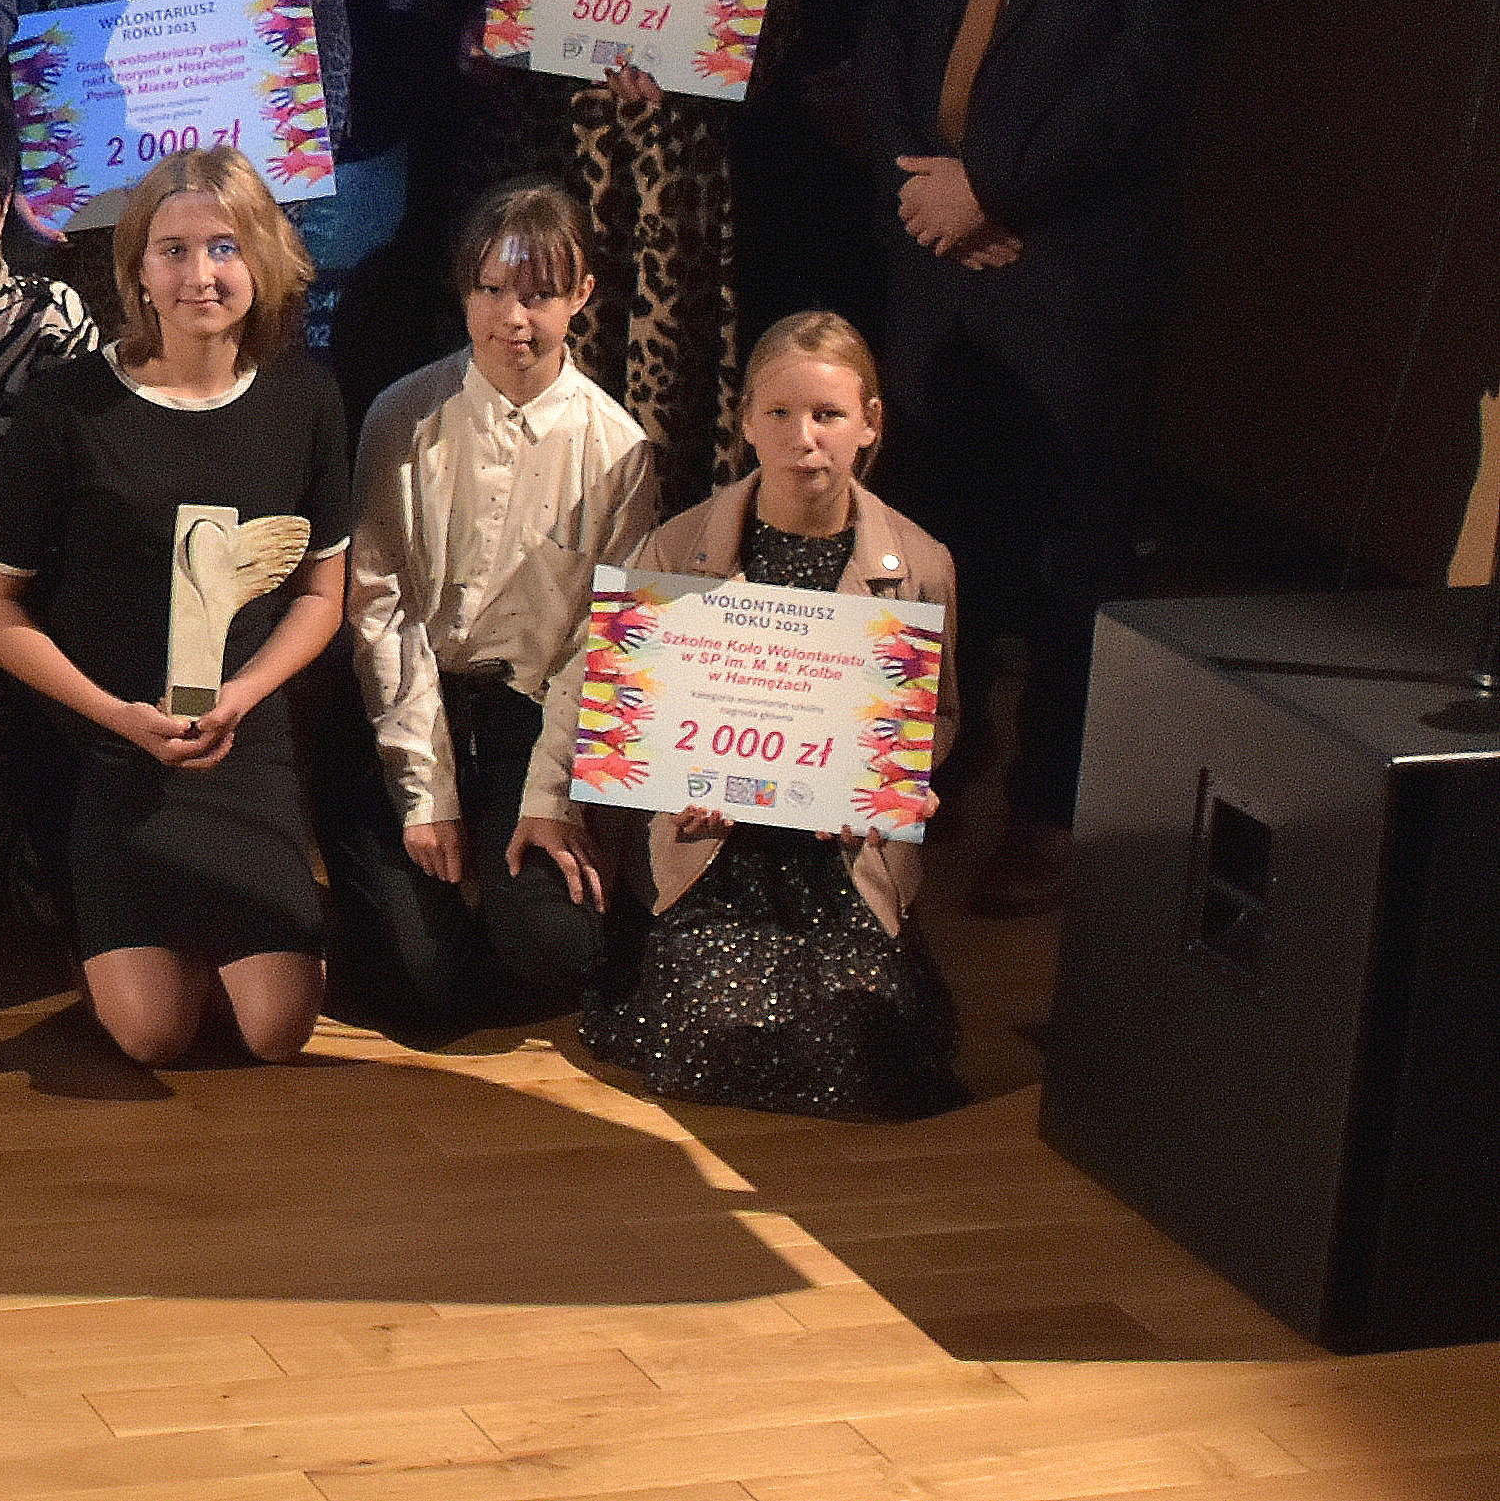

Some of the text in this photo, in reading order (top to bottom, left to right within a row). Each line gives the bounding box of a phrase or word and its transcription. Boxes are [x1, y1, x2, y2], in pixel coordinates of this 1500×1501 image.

[98, 1, 216, 30] WOLONTARIUSZ
[637, 3, 672, 32] zł
[122, 21, 198, 41] ROKU 2023
[177, 53, 246, 74] Hospicjum
[106, 118, 241, 167] 2 000 zł
[701, 594, 836, 621] WOLONTARIUSZ
[723, 612, 810, 637] ROKU 2023
[661, 630, 867, 668] Szkolne Koło Wolontariatu
[681, 651, 843, 681] w SP im. M. M. Kolbe
[708, 671, 812, 694] w Harmężach
[674, 719, 836, 769] 2 000 zł
